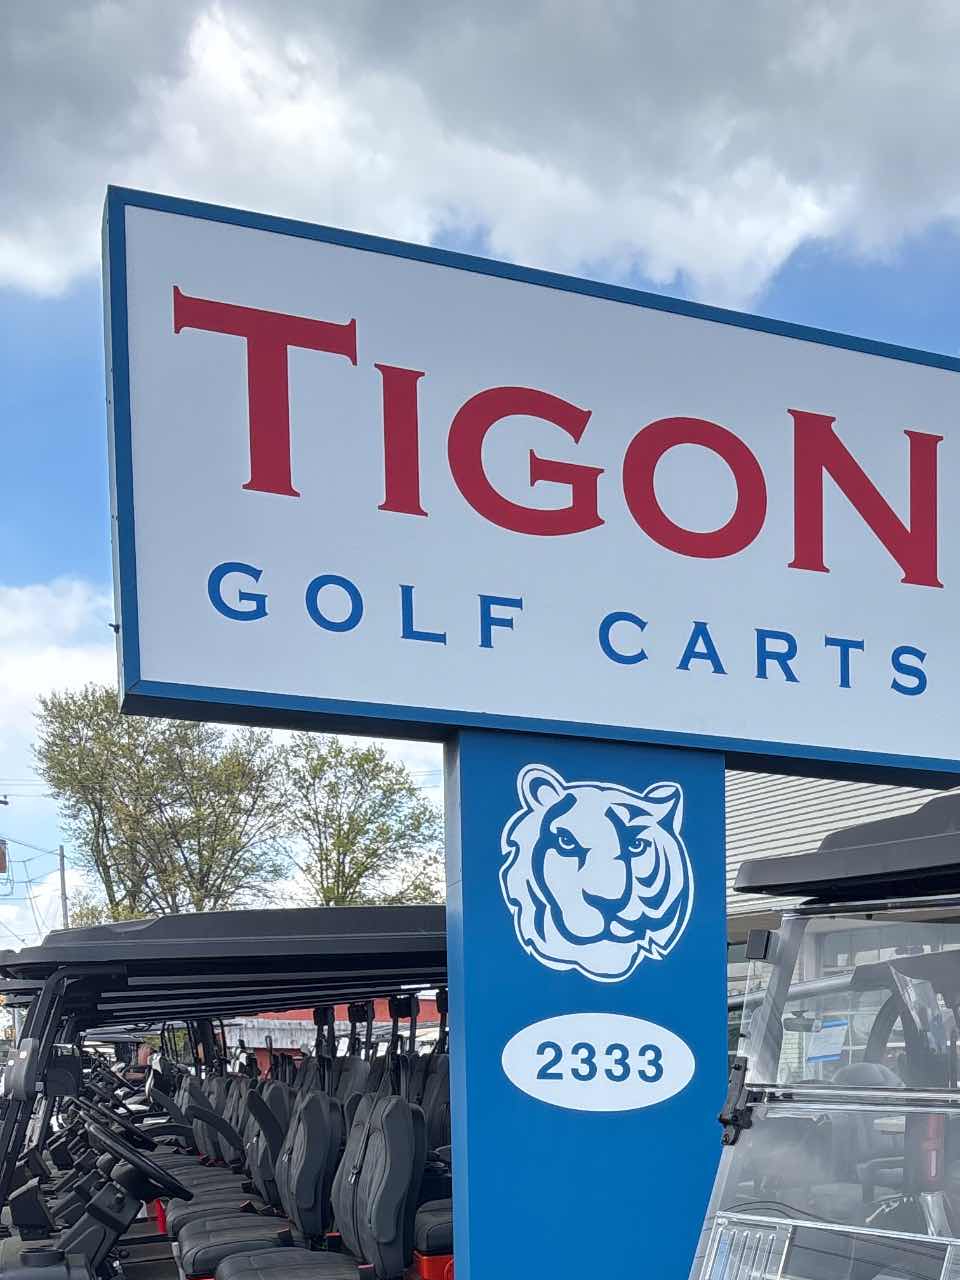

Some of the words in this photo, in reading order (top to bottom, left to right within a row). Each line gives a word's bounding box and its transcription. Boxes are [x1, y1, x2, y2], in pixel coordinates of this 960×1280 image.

[174, 286, 942, 587] TIGON
[207, 559, 525, 651] GOLF
[597, 610, 929, 700] CARTS
[536, 1040, 664, 1083] 2333
